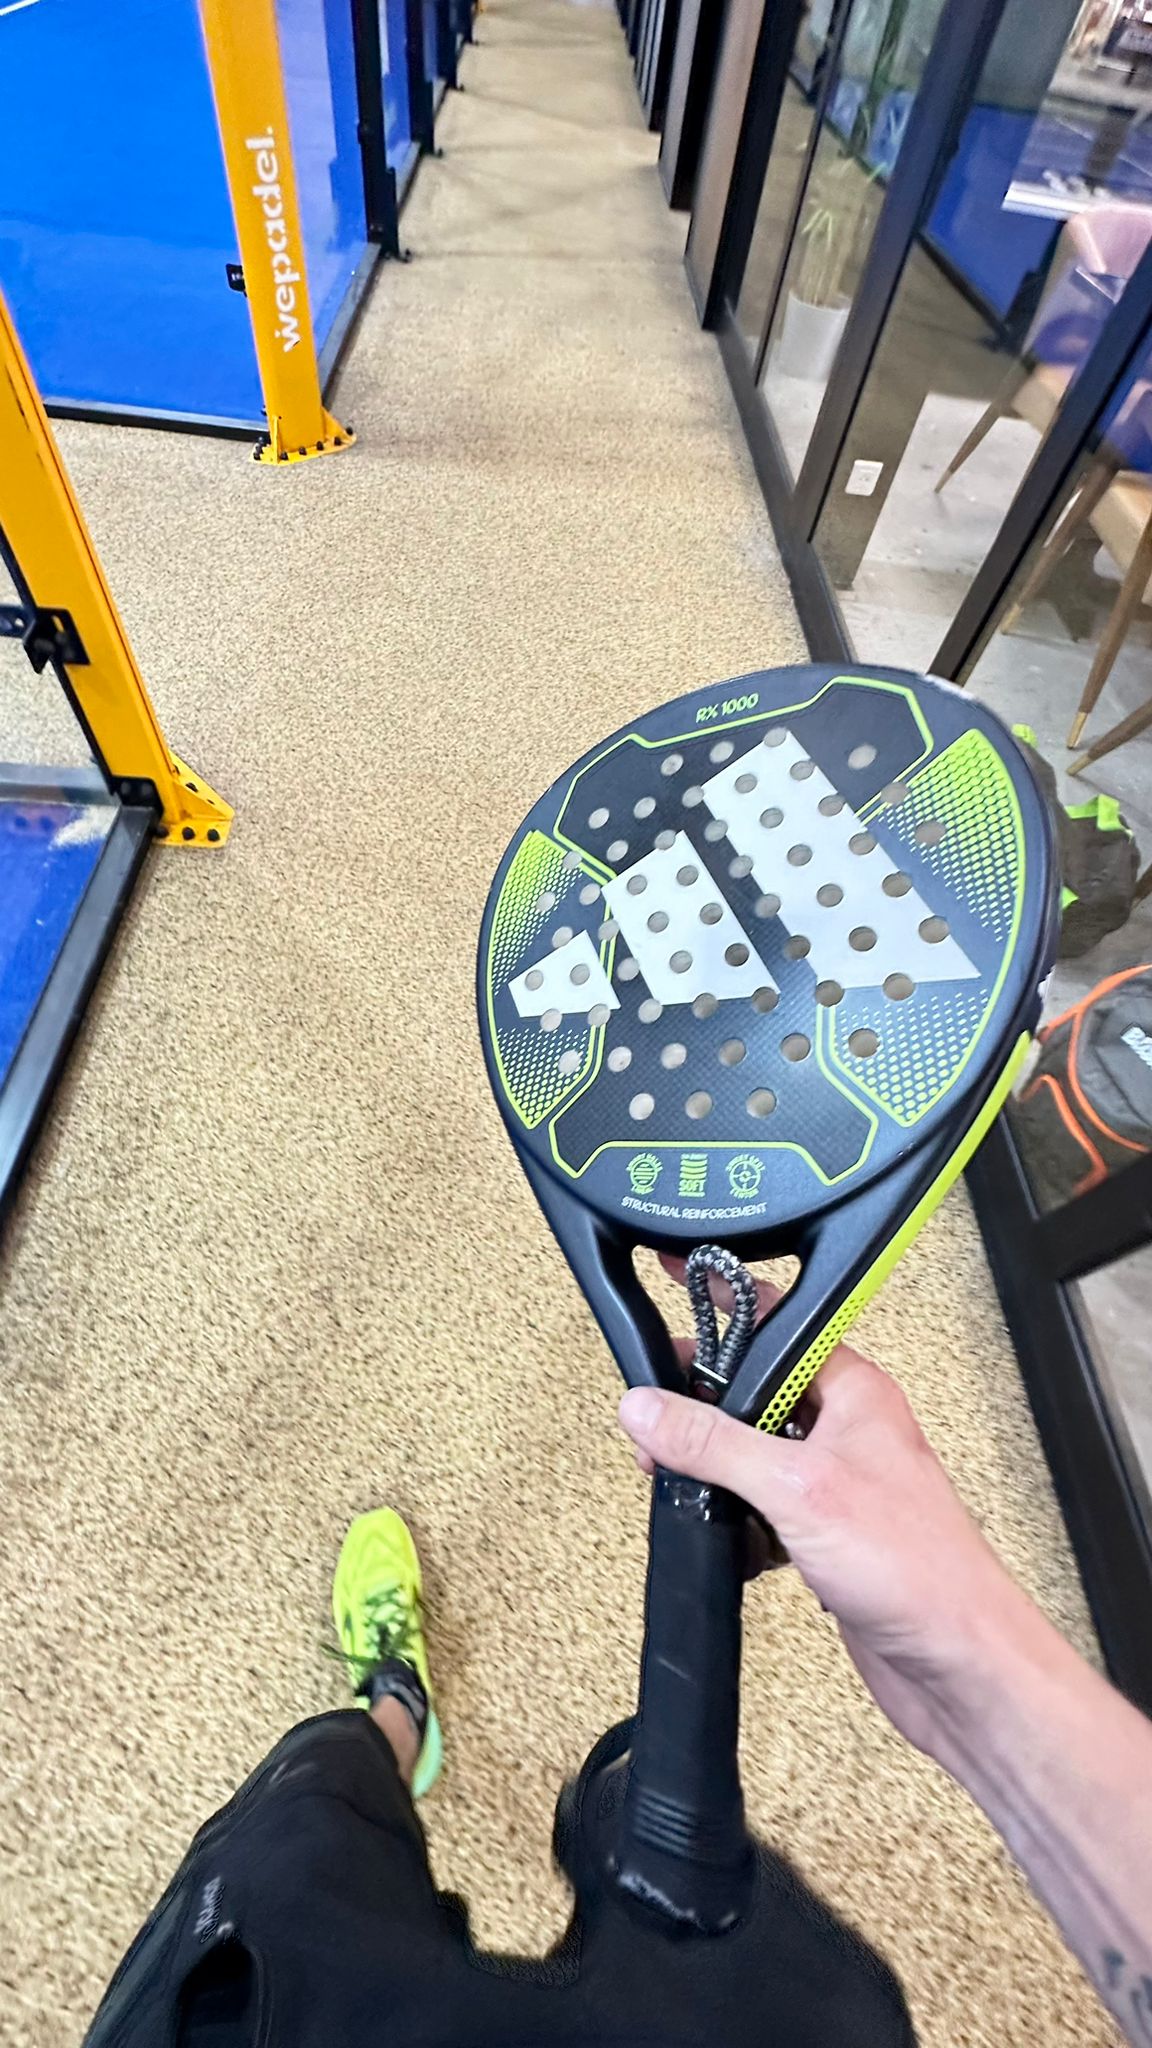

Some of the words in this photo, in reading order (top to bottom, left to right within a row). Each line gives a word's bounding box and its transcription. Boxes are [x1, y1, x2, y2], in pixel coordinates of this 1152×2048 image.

[695, 703, 719, 723] RX
[721, 692, 759, 716] 1000
[621, 1196, 681, 1218] STRUCTURAL
[681, 1202, 767, 1220] REINFORCEMENT
